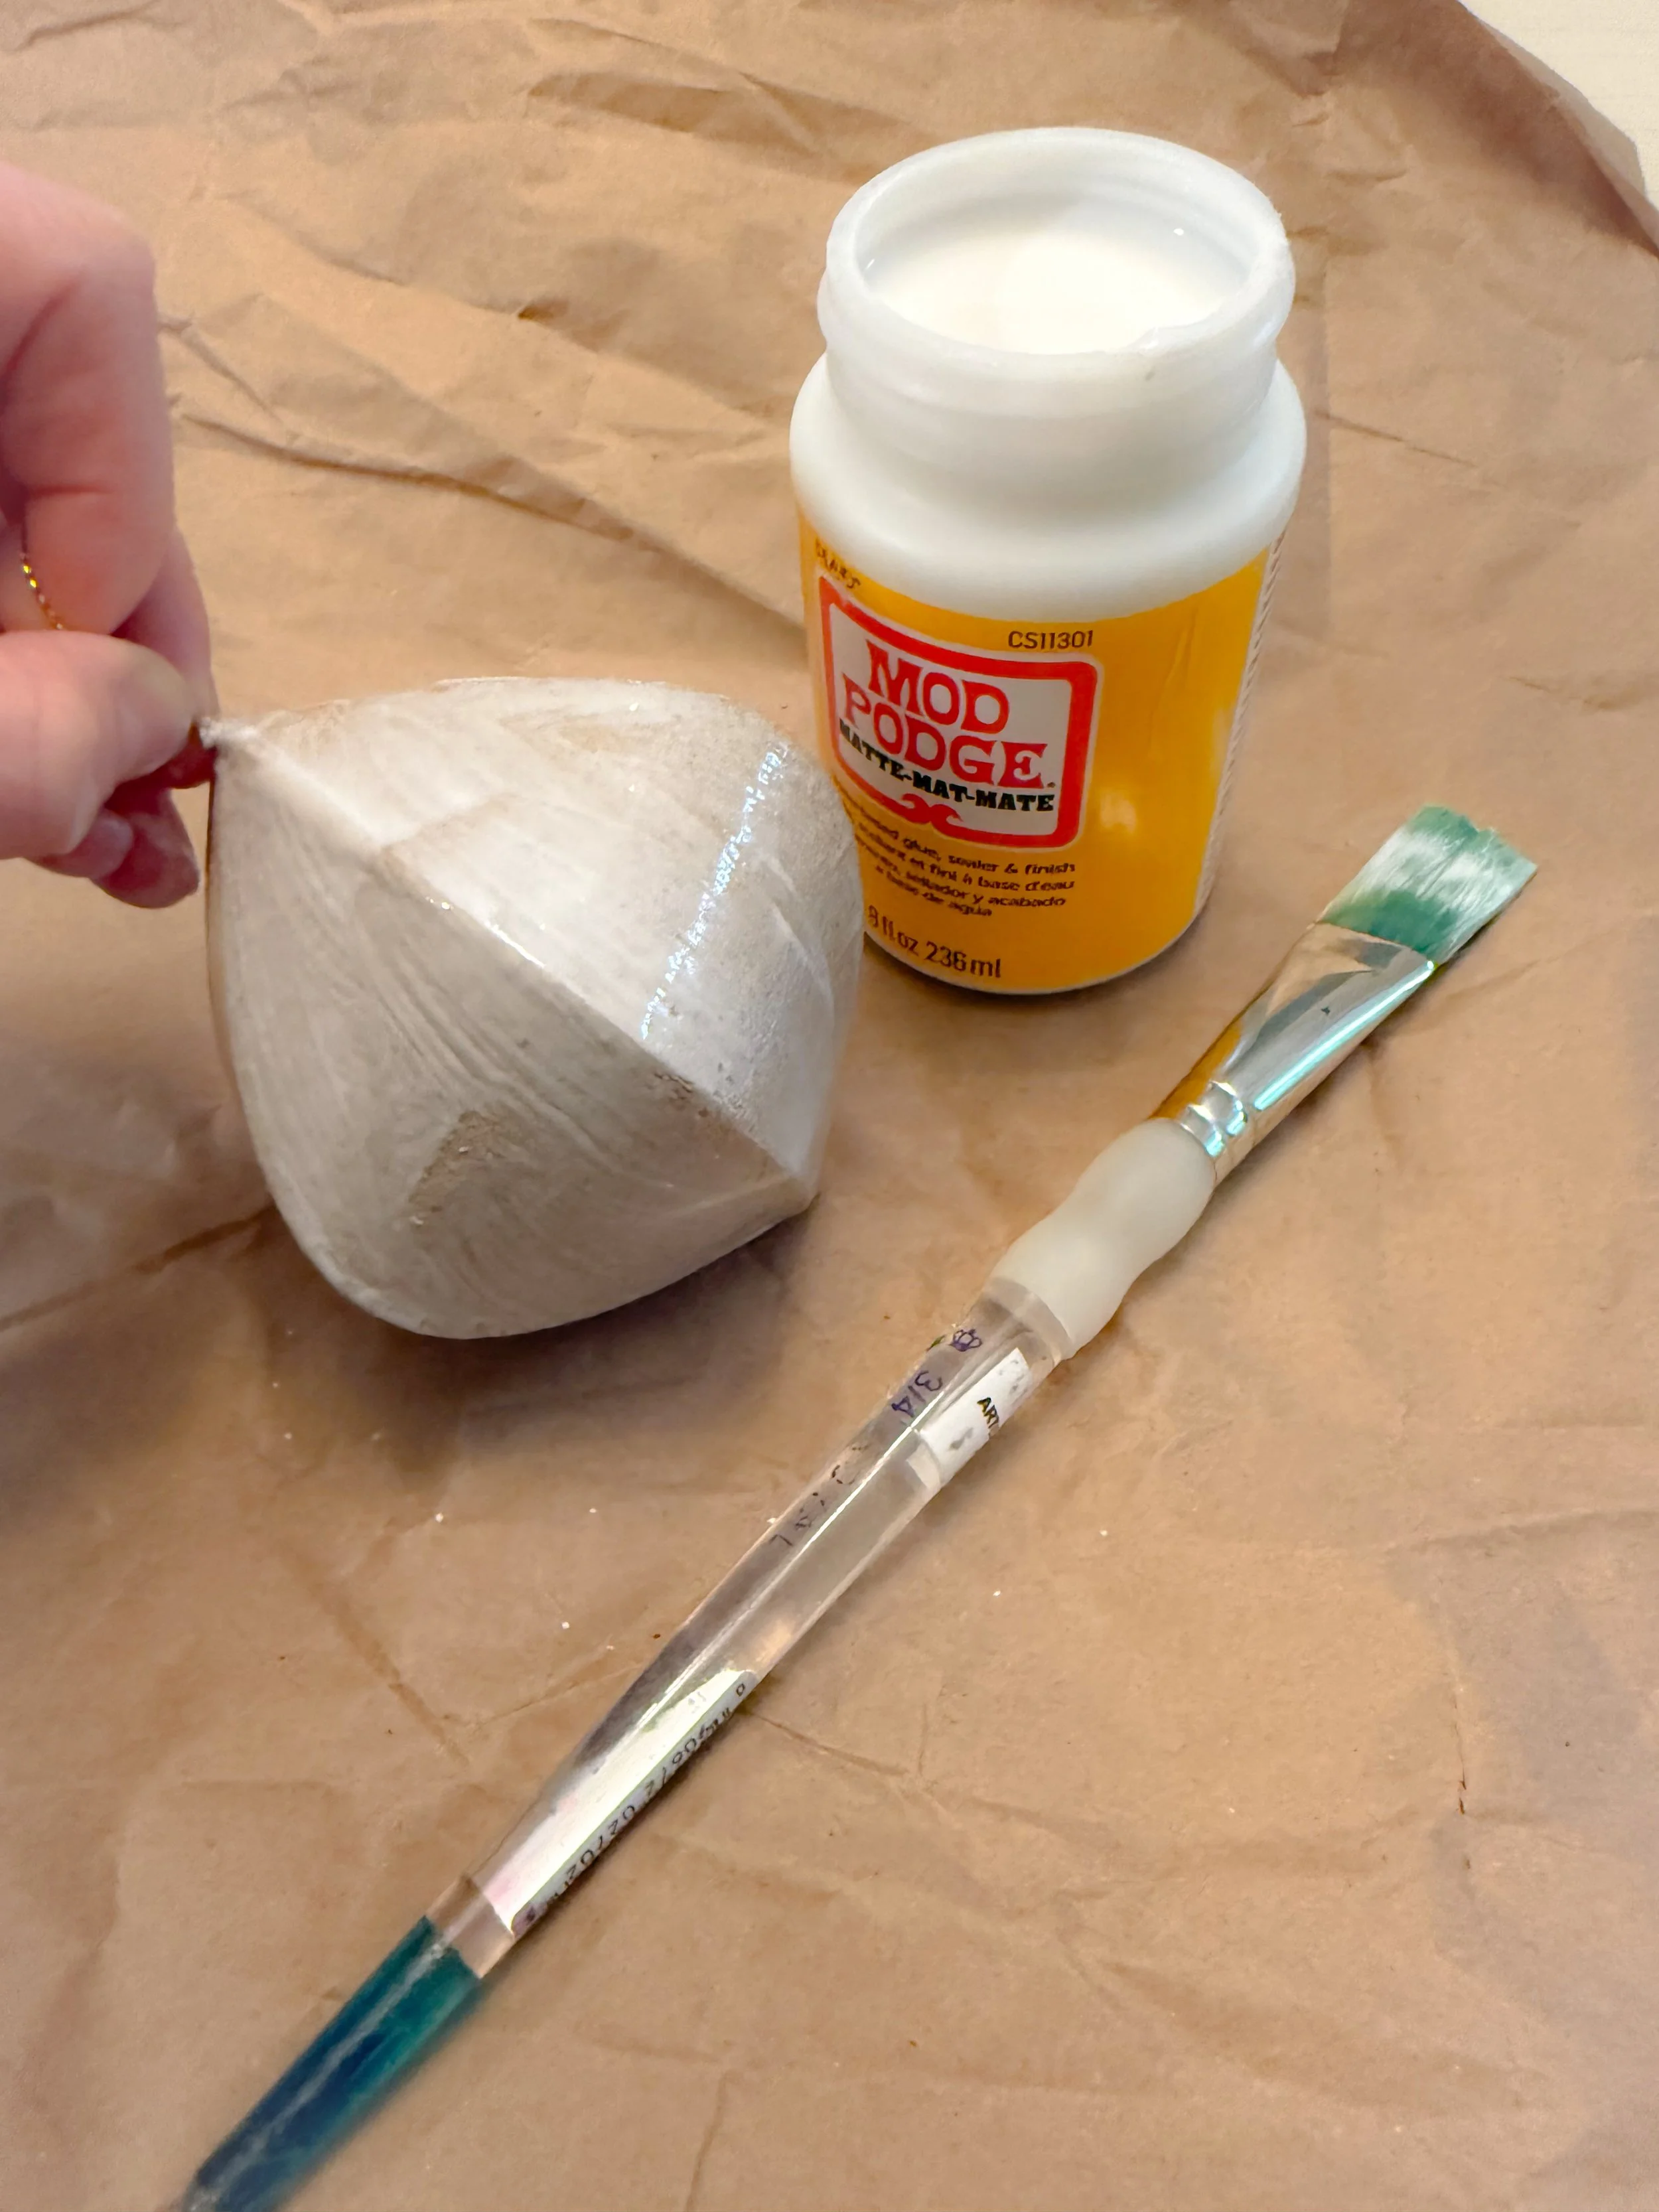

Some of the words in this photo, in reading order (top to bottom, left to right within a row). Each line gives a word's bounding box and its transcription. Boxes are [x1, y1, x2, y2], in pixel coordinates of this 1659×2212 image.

[1008, 630, 1093, 650] CS11301
[866, 638, 1009, 735] MOD
[841, 672, 1048, 789] PODGE
[1025, 863, 1076, 875] finish
[978, 875, 1021, 891] base
[987, 897, 1066, 907] acabado
[923, 940, 968, 972] 236
[970, 958, 1001, 979] ml
